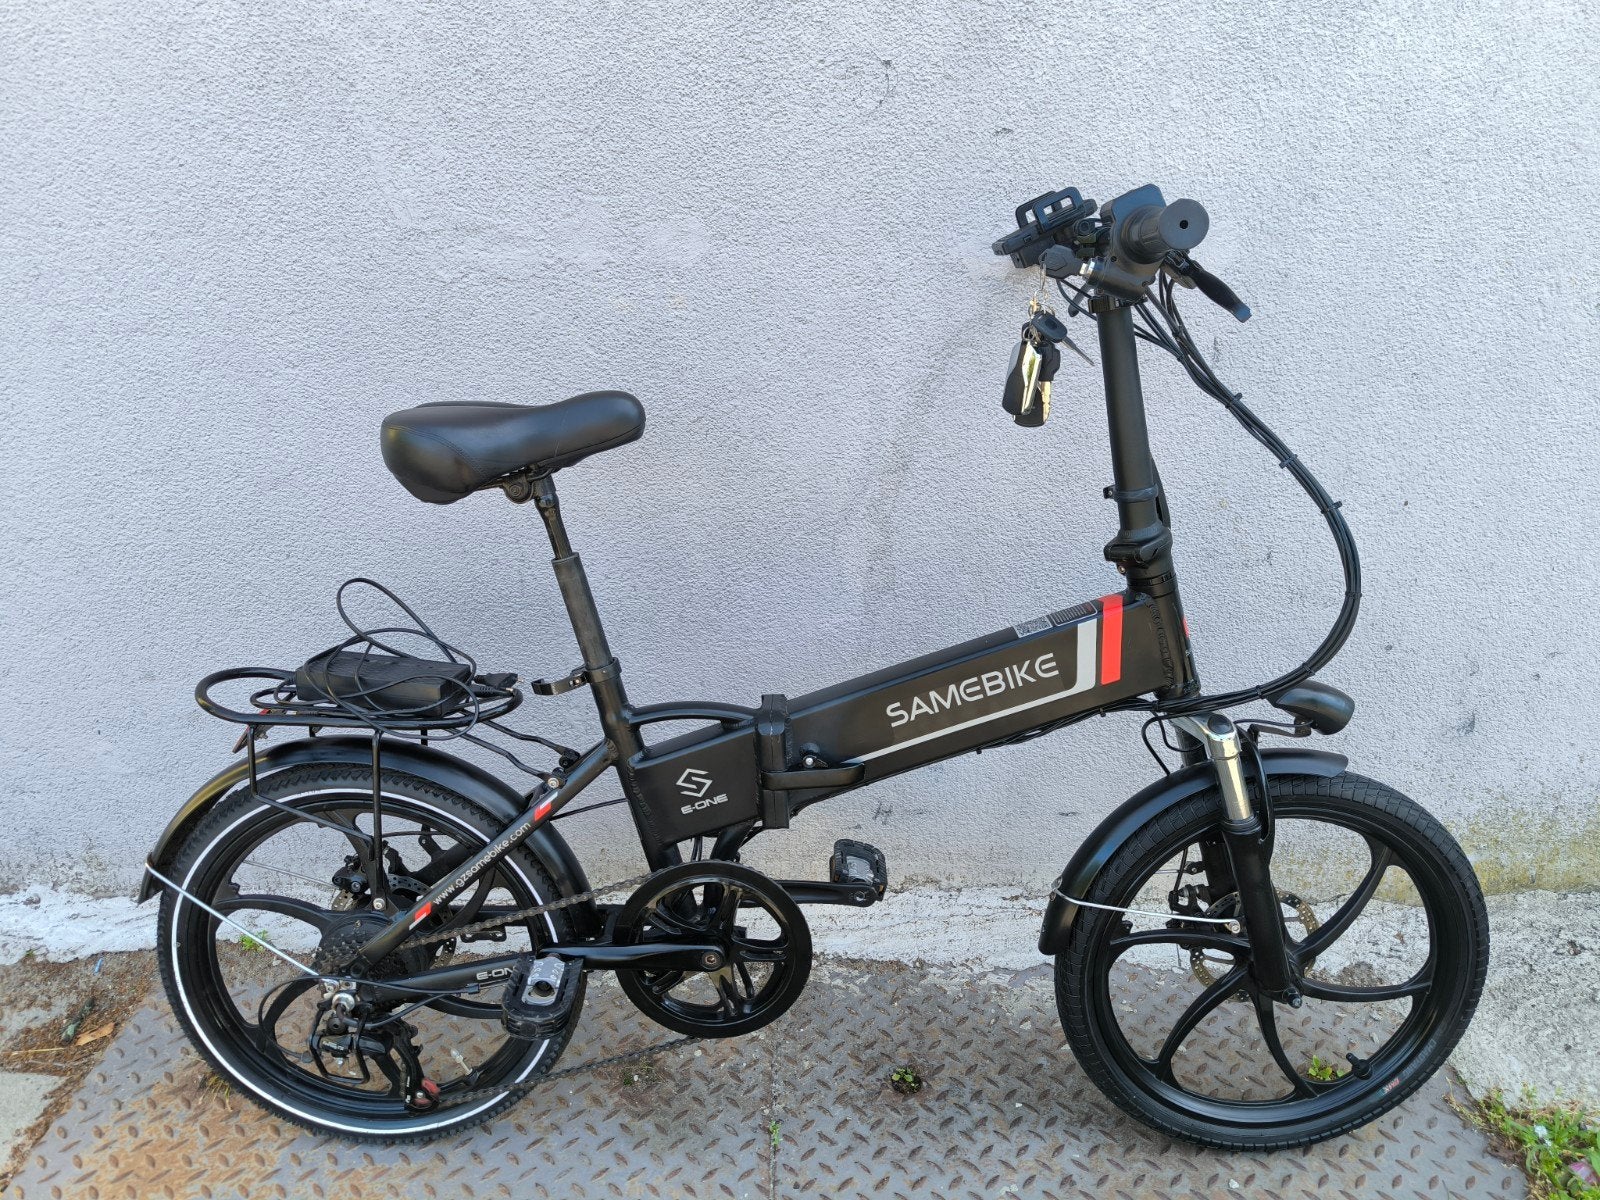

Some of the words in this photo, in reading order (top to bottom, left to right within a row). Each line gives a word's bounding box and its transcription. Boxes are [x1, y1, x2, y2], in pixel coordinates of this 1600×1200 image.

[886, 652, 1060, 728] SAMEBIKE
[680, 793, 729, 815] E-ONE
[432, 822, 532, 906] www.gzsamebike.com
[475, 966, 516, 981] E-ON
